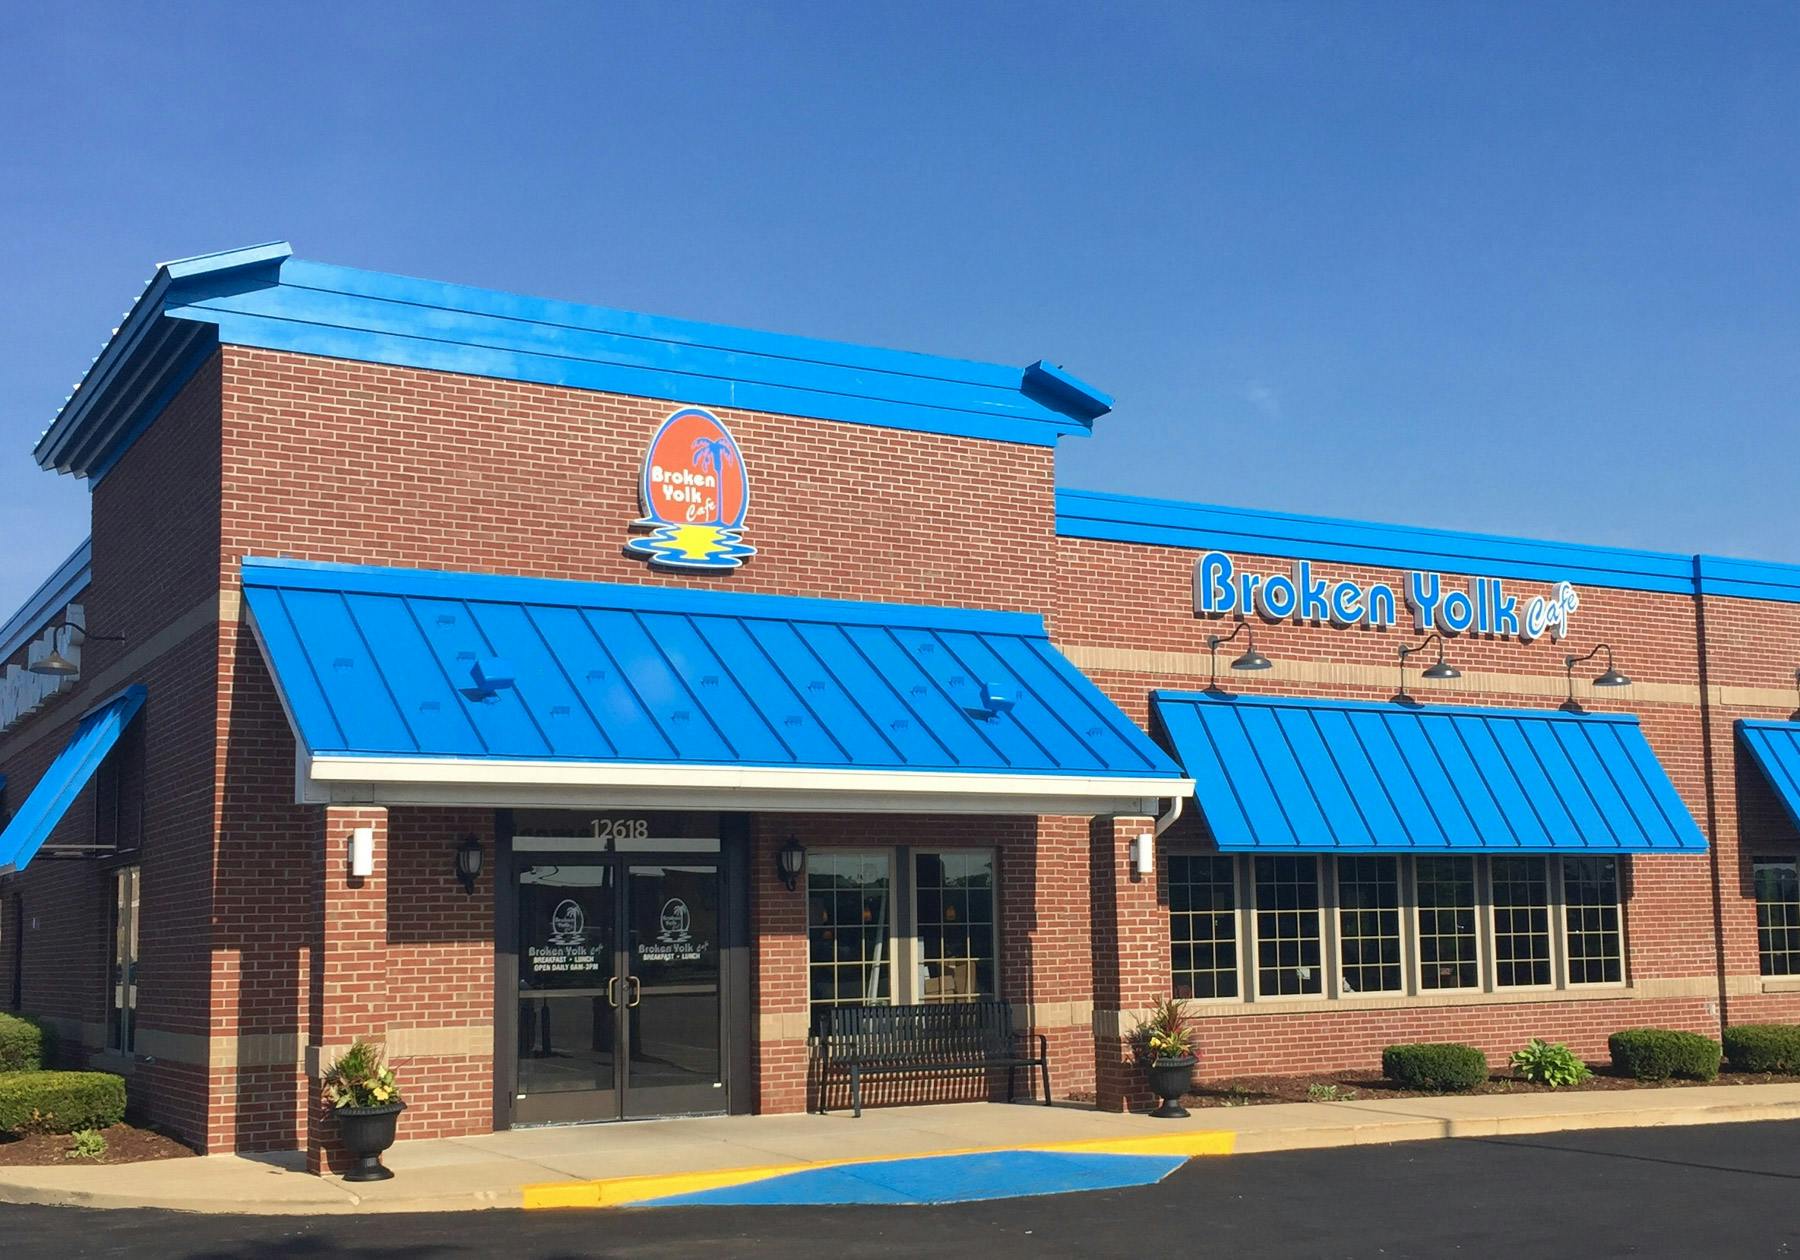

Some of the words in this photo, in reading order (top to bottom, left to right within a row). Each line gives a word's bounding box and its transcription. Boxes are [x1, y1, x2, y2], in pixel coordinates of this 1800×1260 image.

[652, 465, 715, 488] Broken
[662, 483, 702, 503] Yolk
[1198, 550, 1397, 626] Broken
[1408, 570, 1520, 635] Yolk
[1525, 580, 1580, 639] Cafe
[591, 819, 649, 840] 12618
[528, 946, 564, 957] Broken
[565, 946, 587, 956] Yolk
[638, 943, 672, 954] Broken
[673, 943, 694, 953] Yolk
[643, 953, 675, 961] BREAKFAST
[533, 964, 551, 972] OPEN
[551, 963, 569, 971] DAILY
